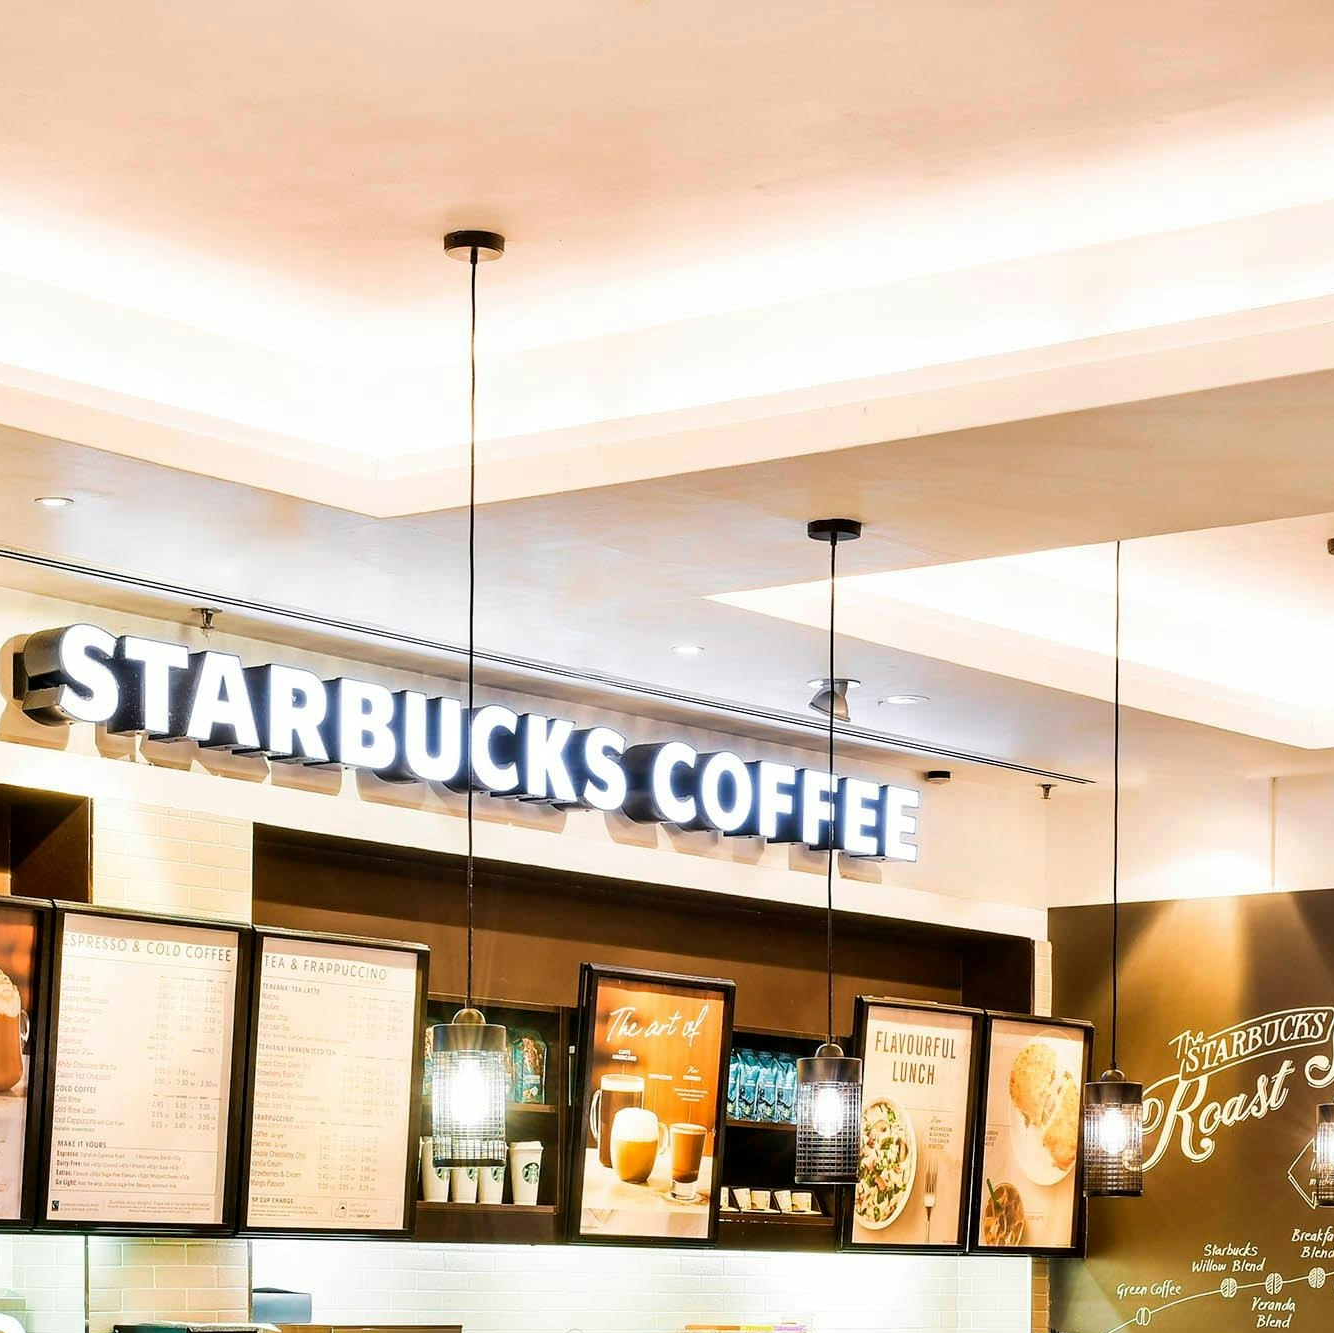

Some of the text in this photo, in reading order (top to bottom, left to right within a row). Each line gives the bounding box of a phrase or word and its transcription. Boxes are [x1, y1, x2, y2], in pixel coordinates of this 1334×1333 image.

[55, 622, 920, 863] STARBUCKS COFFEE
[133, 940, 140, 952] &
[147, 942, 181, 957] COLD
[186, 945, 232, 962] COFFEE
[264, 955, 387, 980] TEA & FRAPPUCCINO
[606, 1004, 709, 1047] The art of
[875, 1031, 956, 1060] FLAVOURFUL
[1168, 1029, 1204, 1059] The
[1186, 1011, 1328, 1073] STARBUCKS
[892, 1061, 935, 1085] LUNCH
[1142, 1058, 1296, 1173] Roast
[1203, 1242, 1258, 1256] Starbucks
[1192, 1258, 1266, 1273] Willow Blend
[1117, 1279, 1183, 1300] Green Coffee
[1251, 1297, 1296, 1313] Veranda
[1256, 1313, 1293, 1328] Blend
